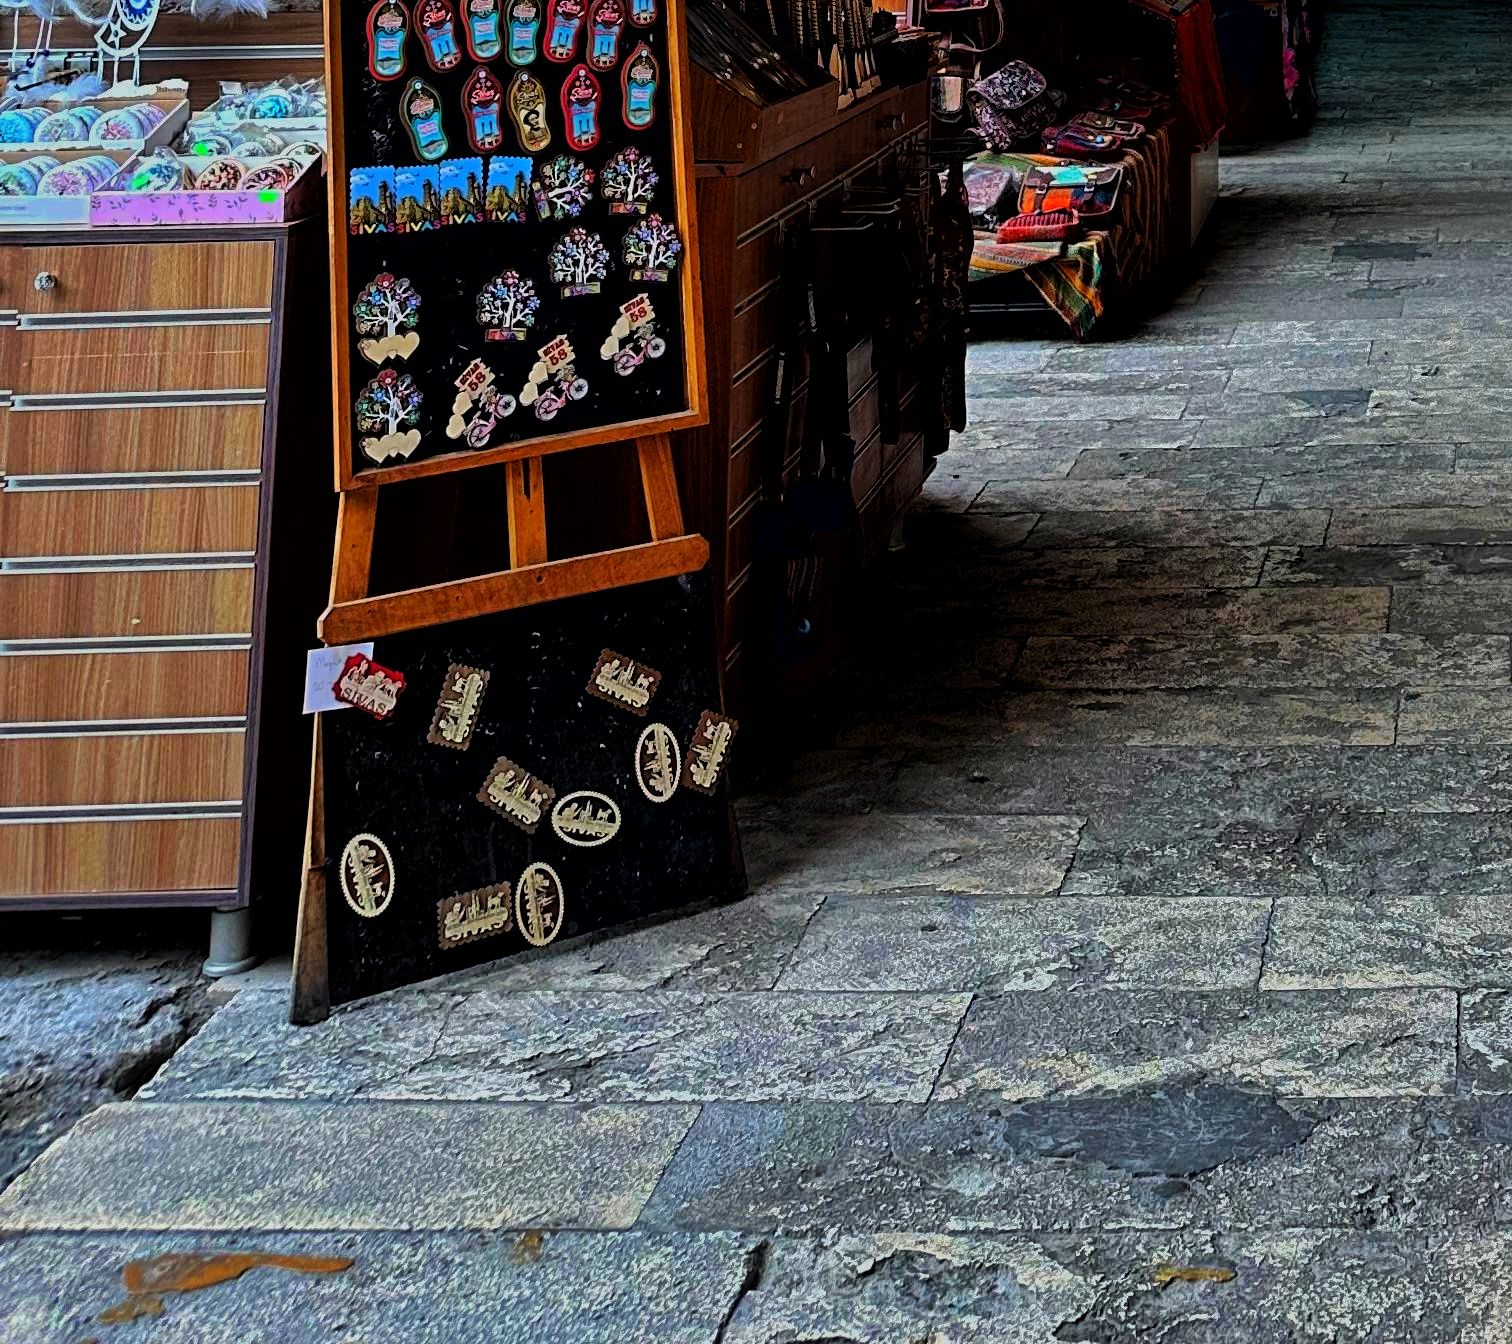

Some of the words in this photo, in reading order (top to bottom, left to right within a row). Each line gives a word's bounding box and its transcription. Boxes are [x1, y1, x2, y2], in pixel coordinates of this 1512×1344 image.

[630, 306, 648, 323] 58
[549, 348, 568, 366] 58
[468, 371, 487, 392] 58
